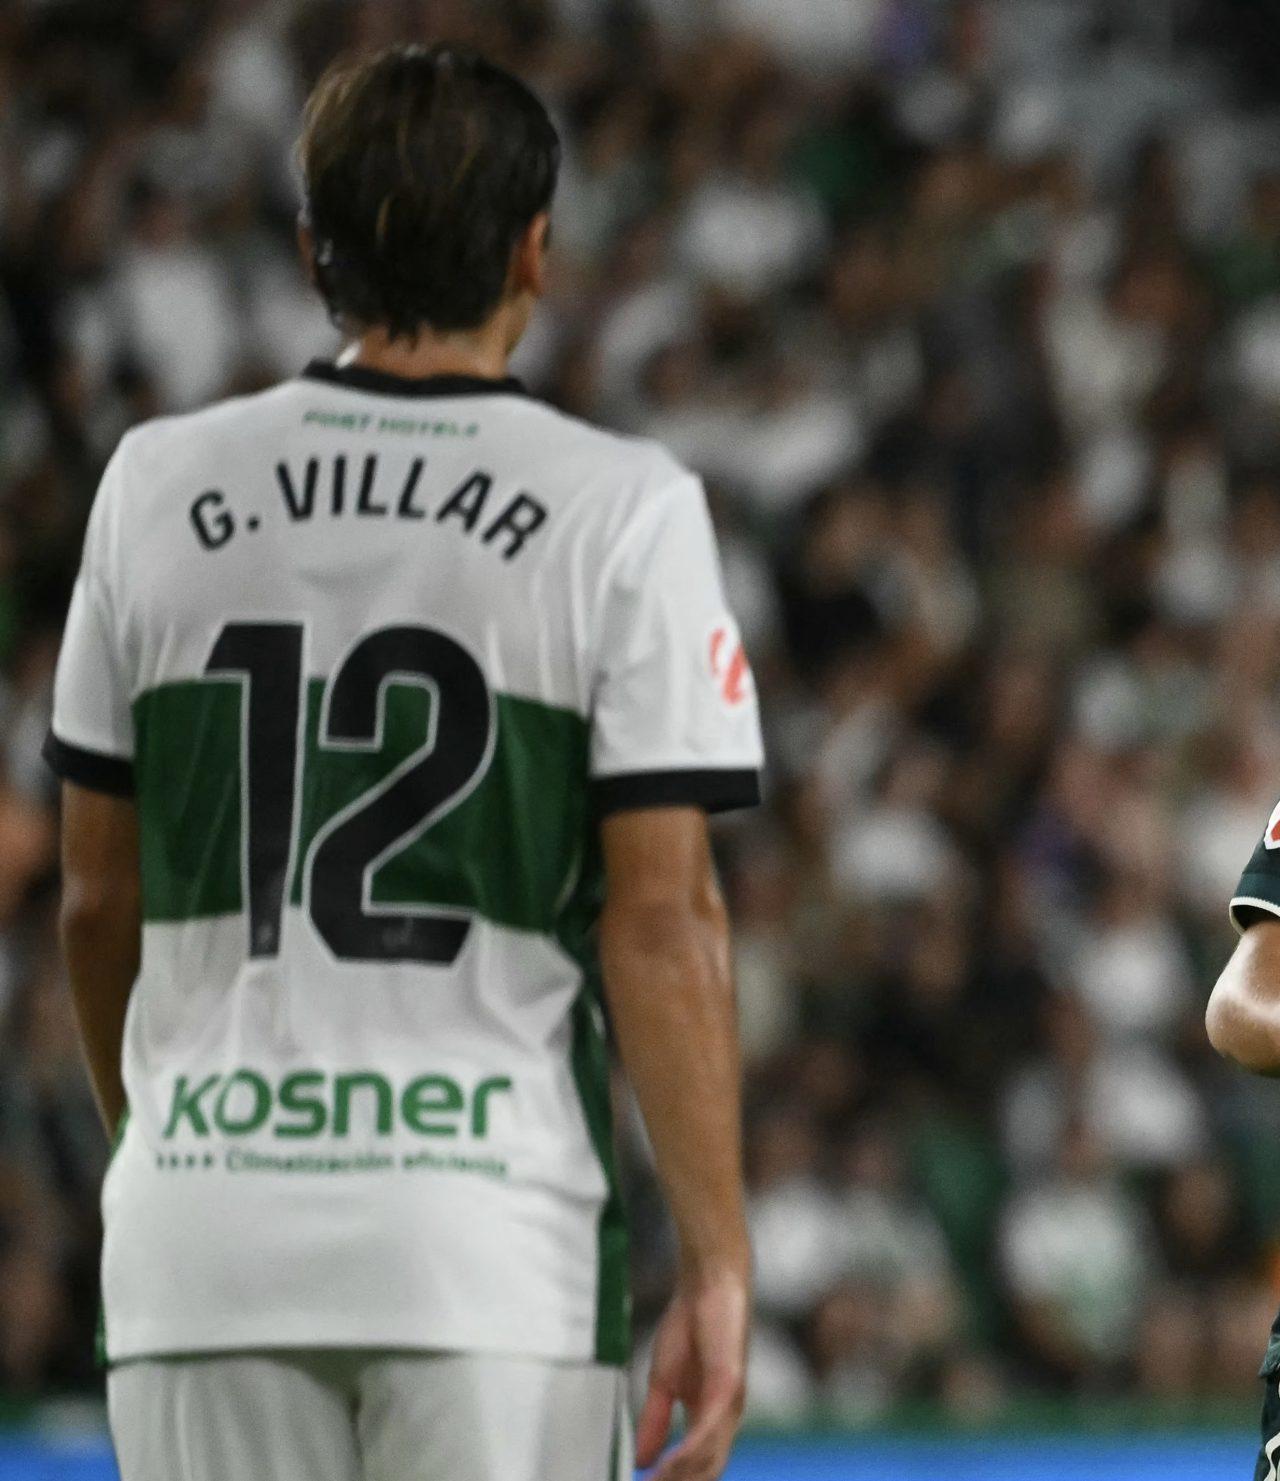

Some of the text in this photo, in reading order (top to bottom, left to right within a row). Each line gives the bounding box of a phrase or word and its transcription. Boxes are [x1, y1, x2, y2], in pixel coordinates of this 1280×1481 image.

[189, 454, 548, 561] G. VILLAR
[203, 621, 494, 968] 12
